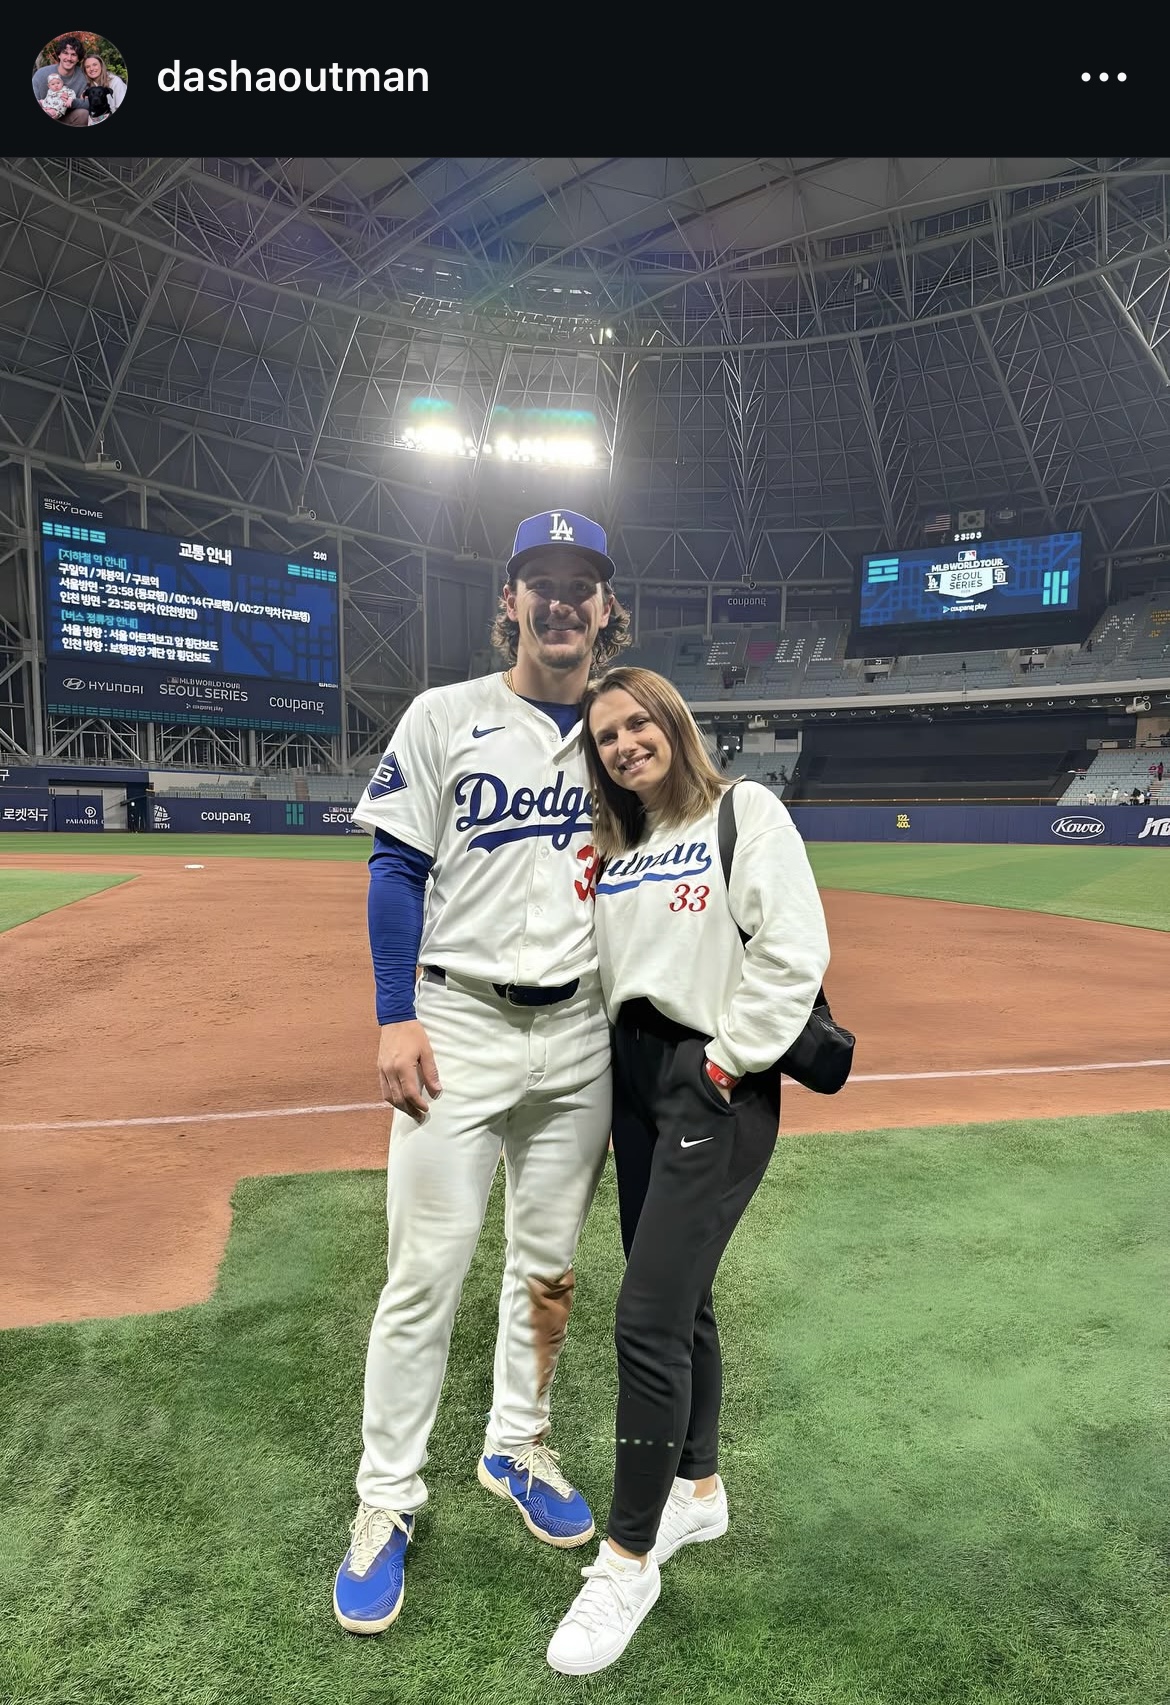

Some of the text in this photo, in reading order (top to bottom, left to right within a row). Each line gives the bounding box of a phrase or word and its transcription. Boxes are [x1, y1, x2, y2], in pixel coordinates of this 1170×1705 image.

[44, 502, 103, 519] SKY DOME
[549, 513, 575, 542] LA
[93, 555, 103, 567] 역
[178, 542, 233, 566] 교통 안내
[931, 557, 1004, 573] MLB WORLD TOUR
[58, 562, 89, 579] 구일역
[95, 568, 125, 584] 개봉역
[131, 573, 160, 589] 구로역
[950, 571, 983, 582] SEOUL
[949, 580, 983, 590] SERIES
[60, 591, 80, 605] 인천
[81, 594, 101, 607] 방면
[107, 597, 136, 611] 23:56
[105, 583, 134, 597] 23:58
[239, 602, 265, 615] 00:27
[727, 597, 767, 607] coupang
[974, 602, 988, 612] play
[61, 623, 82, 637] 서울
[82, 625, 103, 639] 방향
[109, 628, 128, 642] 서울
[174, 636, 184, 648] 앞
[184, 637, 219, 651] 횡단보도
[61, 637, 82, 651] 인천
[83, 639, 103, 653] 방향
[166, 648, 176, 660] 앞
[176, 649, 212, 664] 횡단보도
[88, 680, 144, 695] HYUNDAI
[179, 677, 241, 690] MLB WORLD TOUR
[159, 683, 248, 702] SEOUL SERIES
[269, 696, 325, 715] coupang
[201, 811, 251, 824] coupang
[322, 813, 354, 823] SEOU
[1055, 819, 1103, 833] Kowa
[605, 842, 712, 878] utman
[668, 883, 711, 913] 33
